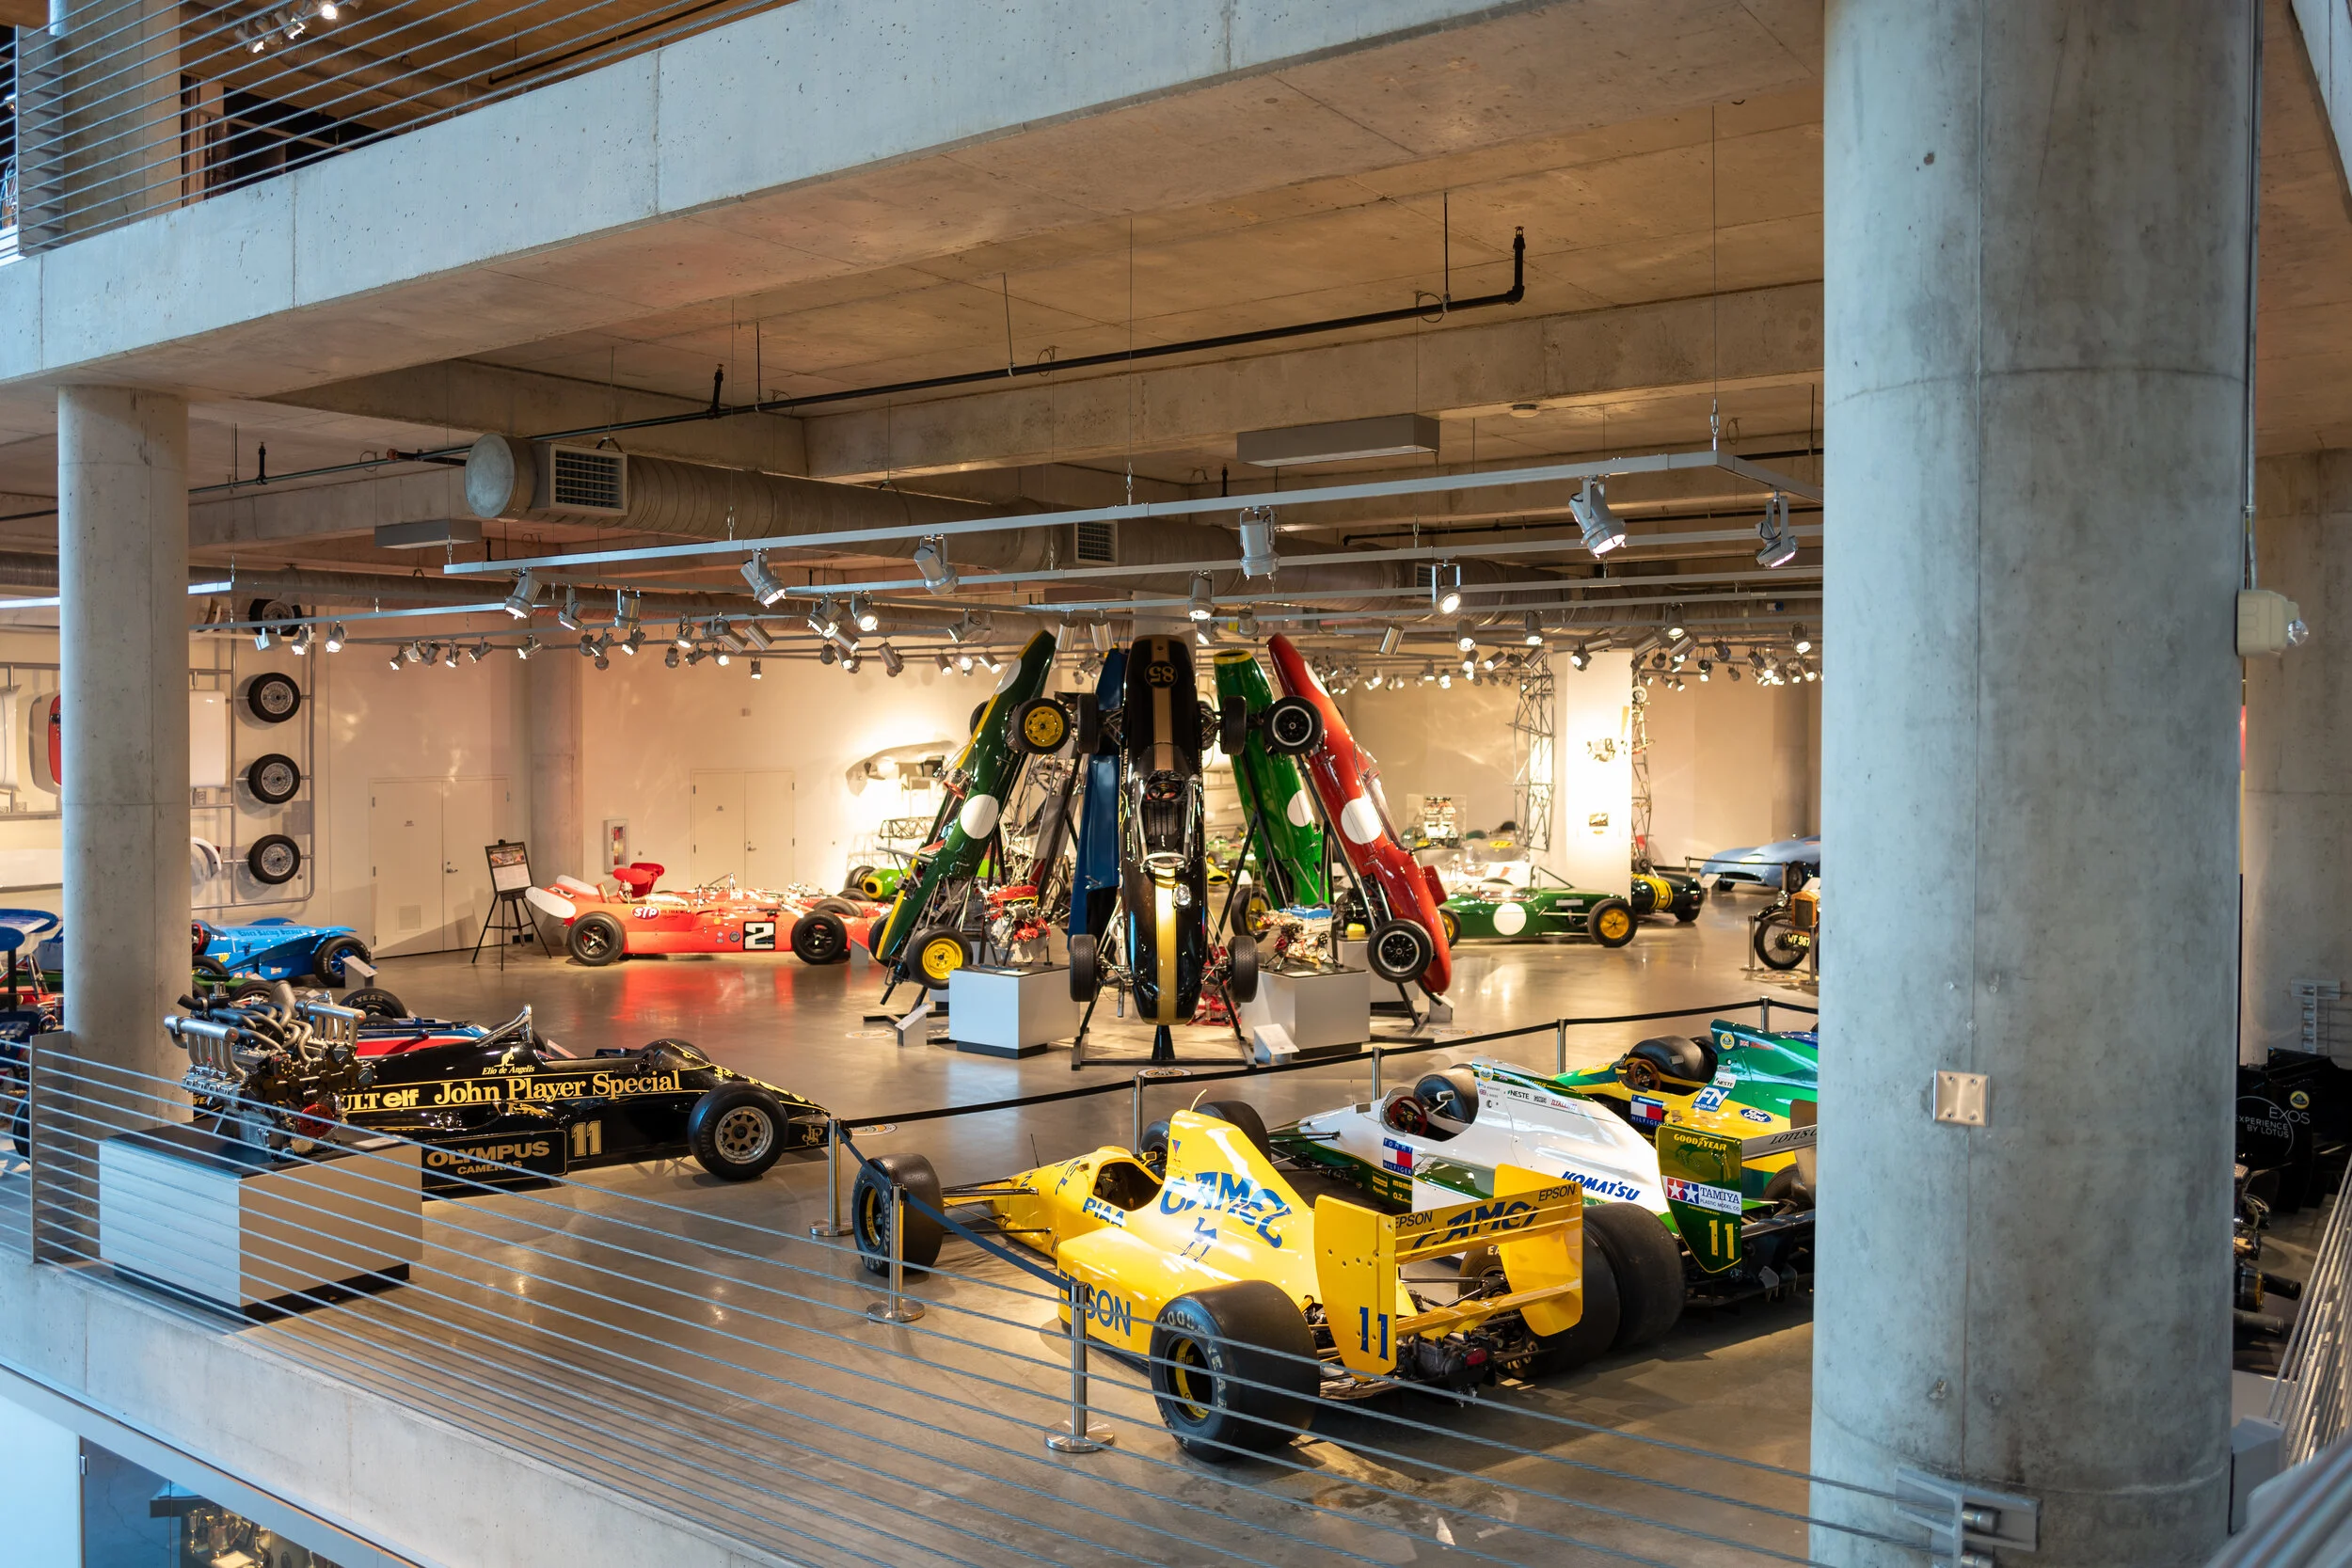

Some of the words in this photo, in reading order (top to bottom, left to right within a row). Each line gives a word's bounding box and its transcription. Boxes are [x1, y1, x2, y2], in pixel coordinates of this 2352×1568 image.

[632, 906, 659, 919] STP
[744, 922, 775, 949] 2
[482, 1067, 497, 1076] Elio
[499, 1066, 508, 1074] de
[510, 1064, 535, 1074] Angelis
[382, 1088, 420, 1108] elf
[434, 1082, 501, 1104] John
[506, 1077, 587, 1103] Player
[592, 1069, 683, 1101] Special
[1510, 1089, 1530, 1101] NESTE
[1695, 1086, 1730, 1107] FN
[2269, 1106, 2311, 1125] EXOS
[571, 1119, 602, 1158] 11
[2247, 1124, 2258, 1132] BY
[2261, 1128, 2290, 1139] LOTUS
[1674, 1133, 1727, 1151] GOODYEAR
[426, 1140, 550, 1167] OLYMPUS
[456, 1159, 523, 1176] CAMERAS
[1383, 1160, 1412, 1176] HILFIGER
[1538, 1183, 1577, 1203] EPSON
[1561, 1170, 1641, 1201] KOMATSU
[1700, 1186, 1740, 1205] TAMIYA
[1082, 1196, 1125, 1228] PIAA
[1159, 1171, 1293, 1249] CAMEL
[1394, 1211, 1434, 1230] EPSON
[1708, 1219, 1735, 1260] 11
[1359, 1306, 1390, 1361] 11
